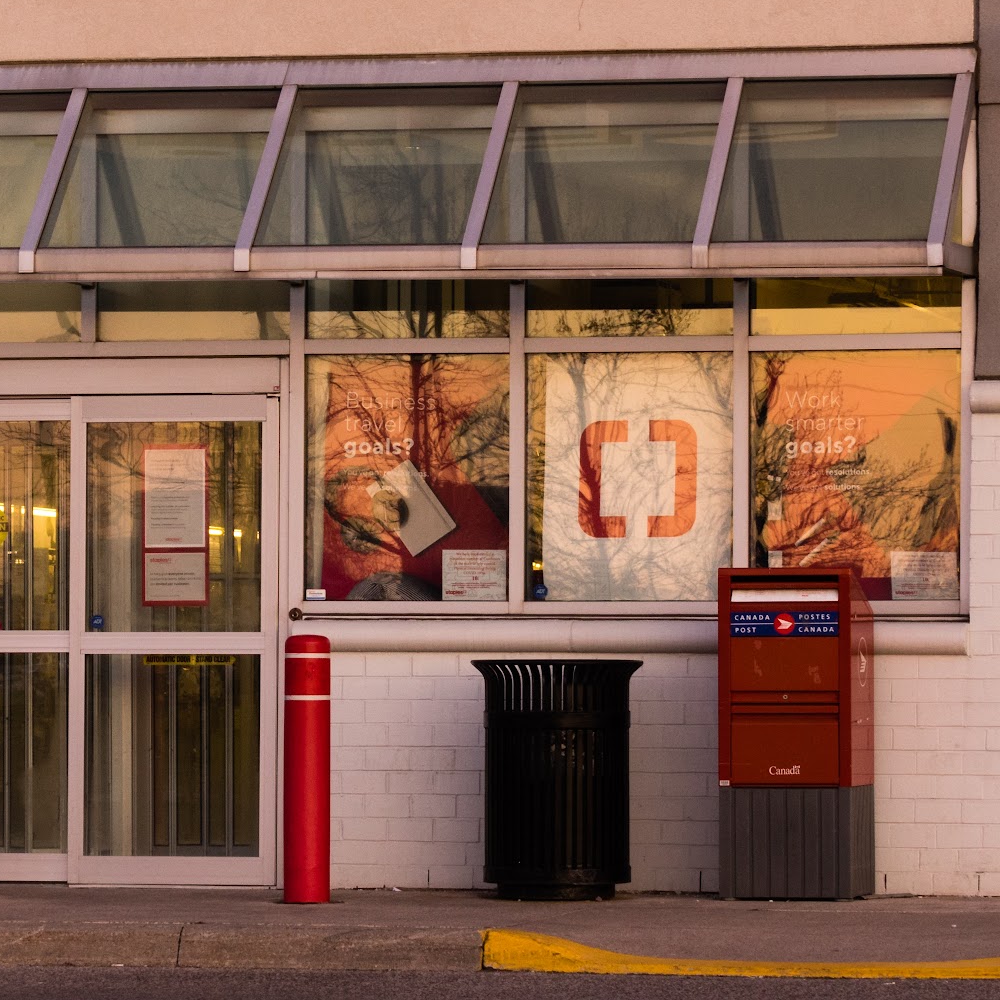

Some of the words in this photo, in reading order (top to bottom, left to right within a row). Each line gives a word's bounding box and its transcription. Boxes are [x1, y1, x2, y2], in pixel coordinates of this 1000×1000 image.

[346, 391, 436, 411] Business
[785, 391, 841, 409] Work
[344, 415, 402, 432] travel
[785, 415, 865, 432] smarter
[344, 437, 415, 458] goals?
[785, 435, 857, 459] goals?
[768, 765, 801, 776] Canada
